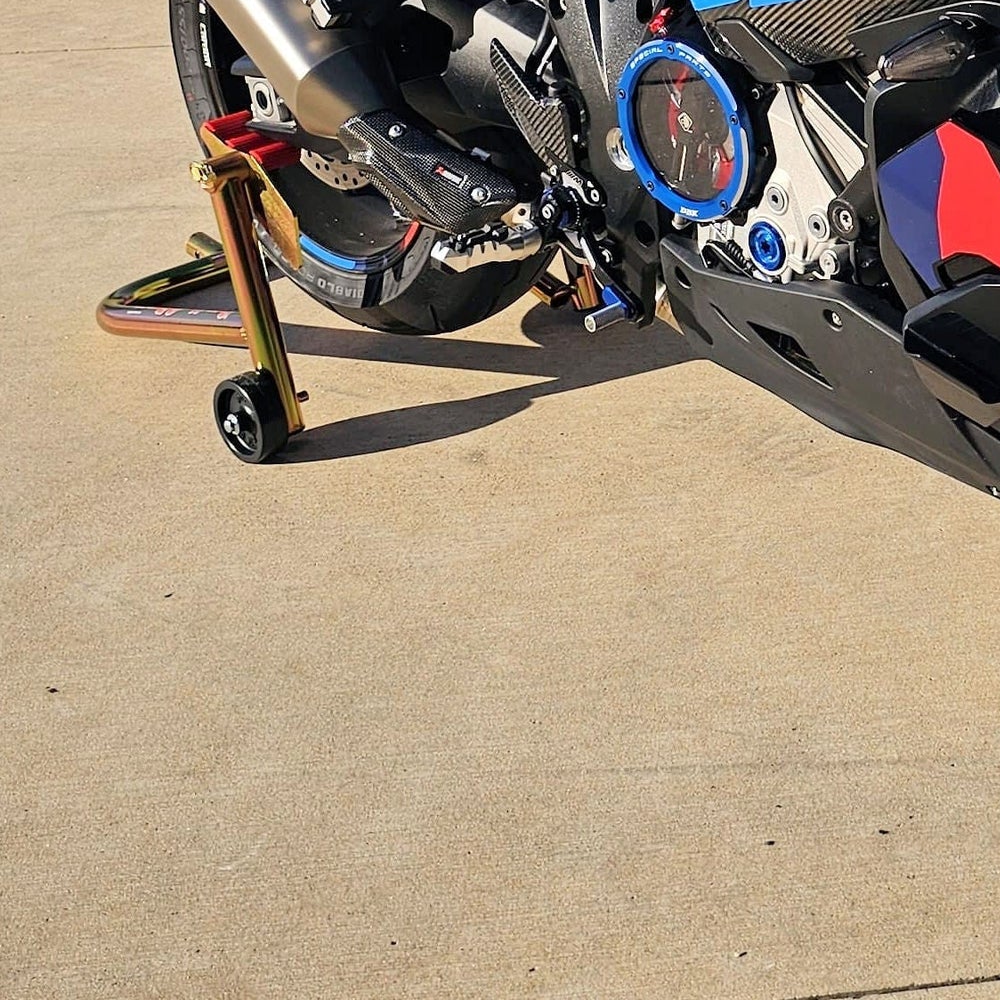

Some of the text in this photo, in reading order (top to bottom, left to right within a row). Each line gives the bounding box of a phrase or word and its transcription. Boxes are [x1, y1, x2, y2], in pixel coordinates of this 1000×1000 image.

[630, 47, 664, 70] SPECIAL
[678, 51, 712, 78] PARTS
[316, 277, 365, 299] DIABLO
